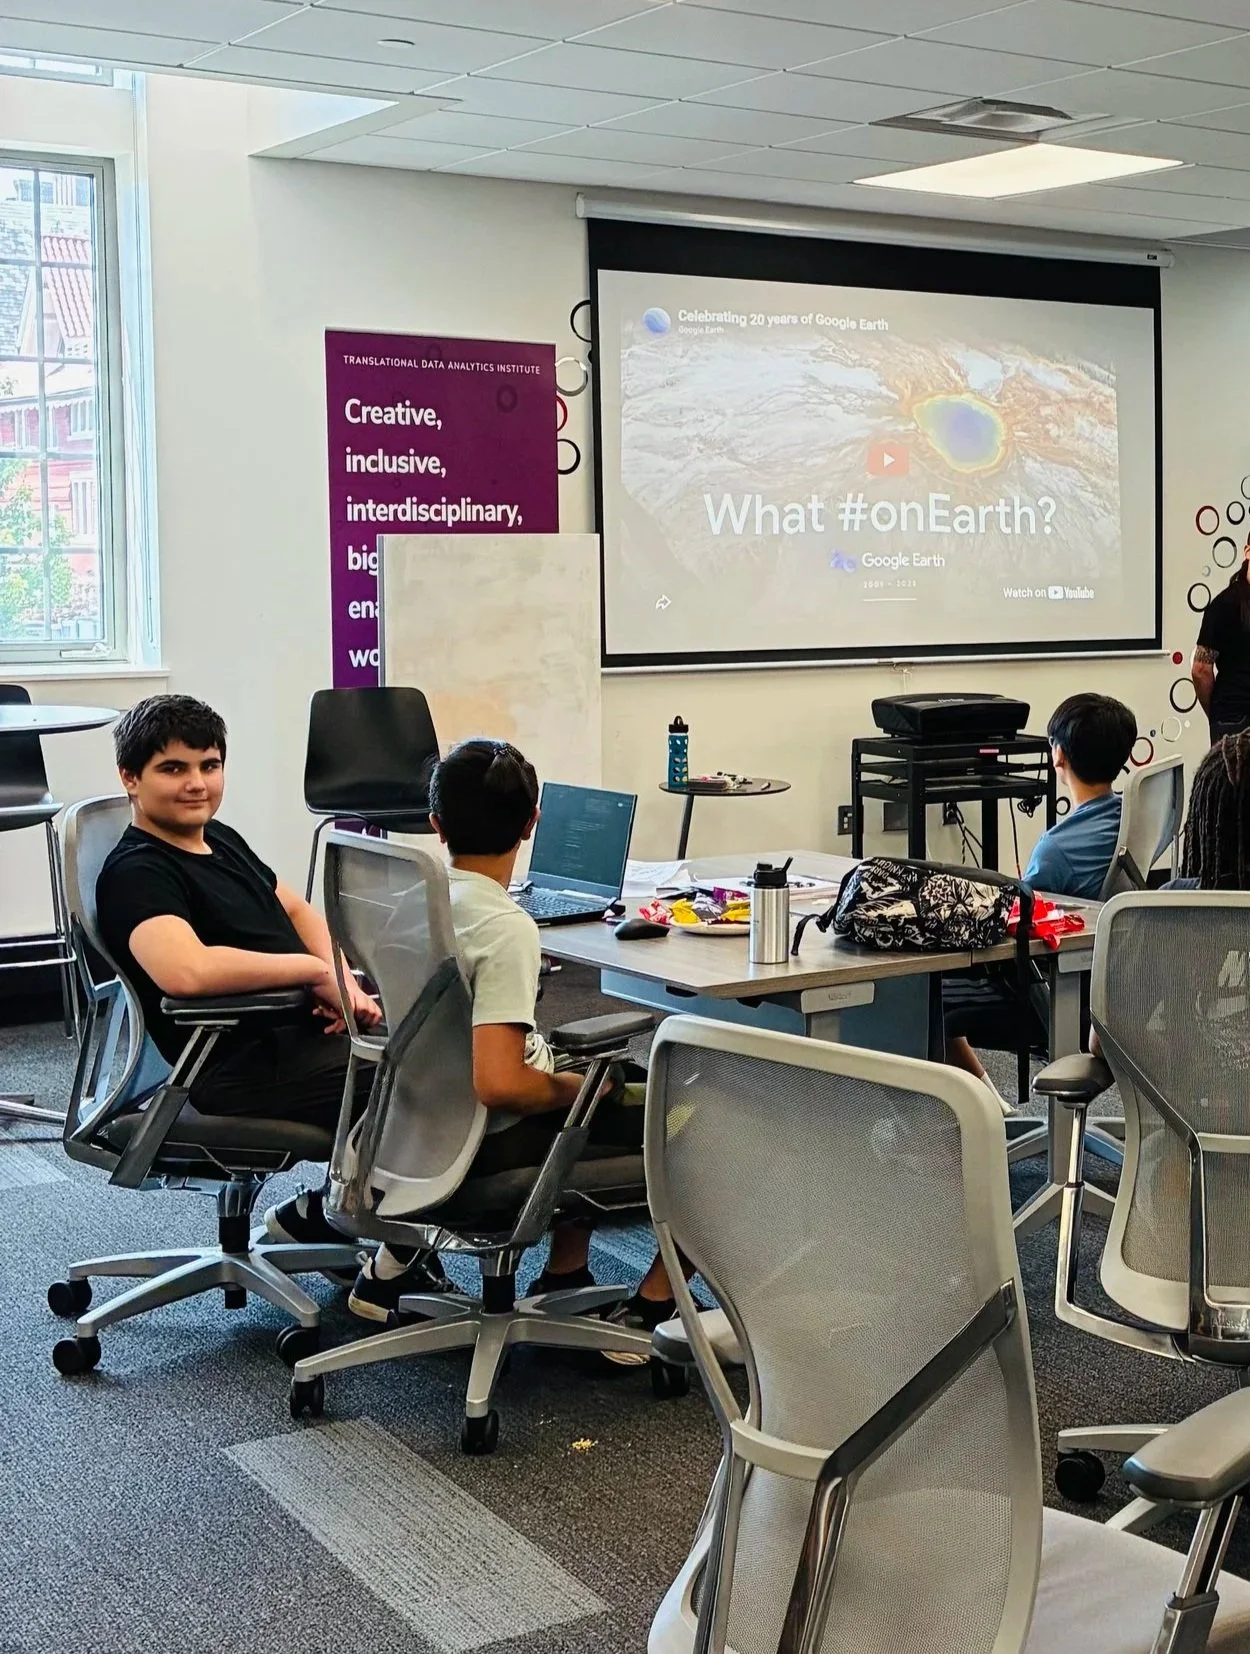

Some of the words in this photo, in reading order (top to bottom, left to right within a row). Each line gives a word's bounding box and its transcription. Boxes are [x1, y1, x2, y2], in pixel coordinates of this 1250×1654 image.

[678, 309, 748, 327] Celebrating
[749, 314, 765, 325] 20
[767, 314, 798, 327] years
[801, 313, 813, 324] of
[815, 313, 857, 330] Google
[859, 319, 889, 330] Earth
[678, 325, 705, 335] Google
[706, 326, 724, 334] Earth
[343, 355, 418, 369] TRANSLATIONAL
[421, 359, 445, 369] DATA
[448, 361, 494, 372] ANALYTICS
[497, 363, 541, 375] INSTITUTE
[344, 398, 443, 430] Creative,
[345, 447, 447, 478] inclusive,
[346, 496, 523, 527] interdisciplinary,
[703, 493, 825, 536] What
[838, 492, 1056, 536] #onEarth?
[862, 552, 910, 570] Google
[913, 552, 945, 567] Earth
[1003, 587, 1033, 598] Watch
[1034, 588, 1047, 598] on
[1064, 586, 1095, 599] YouTube
[348, 600, 379, 619] en
